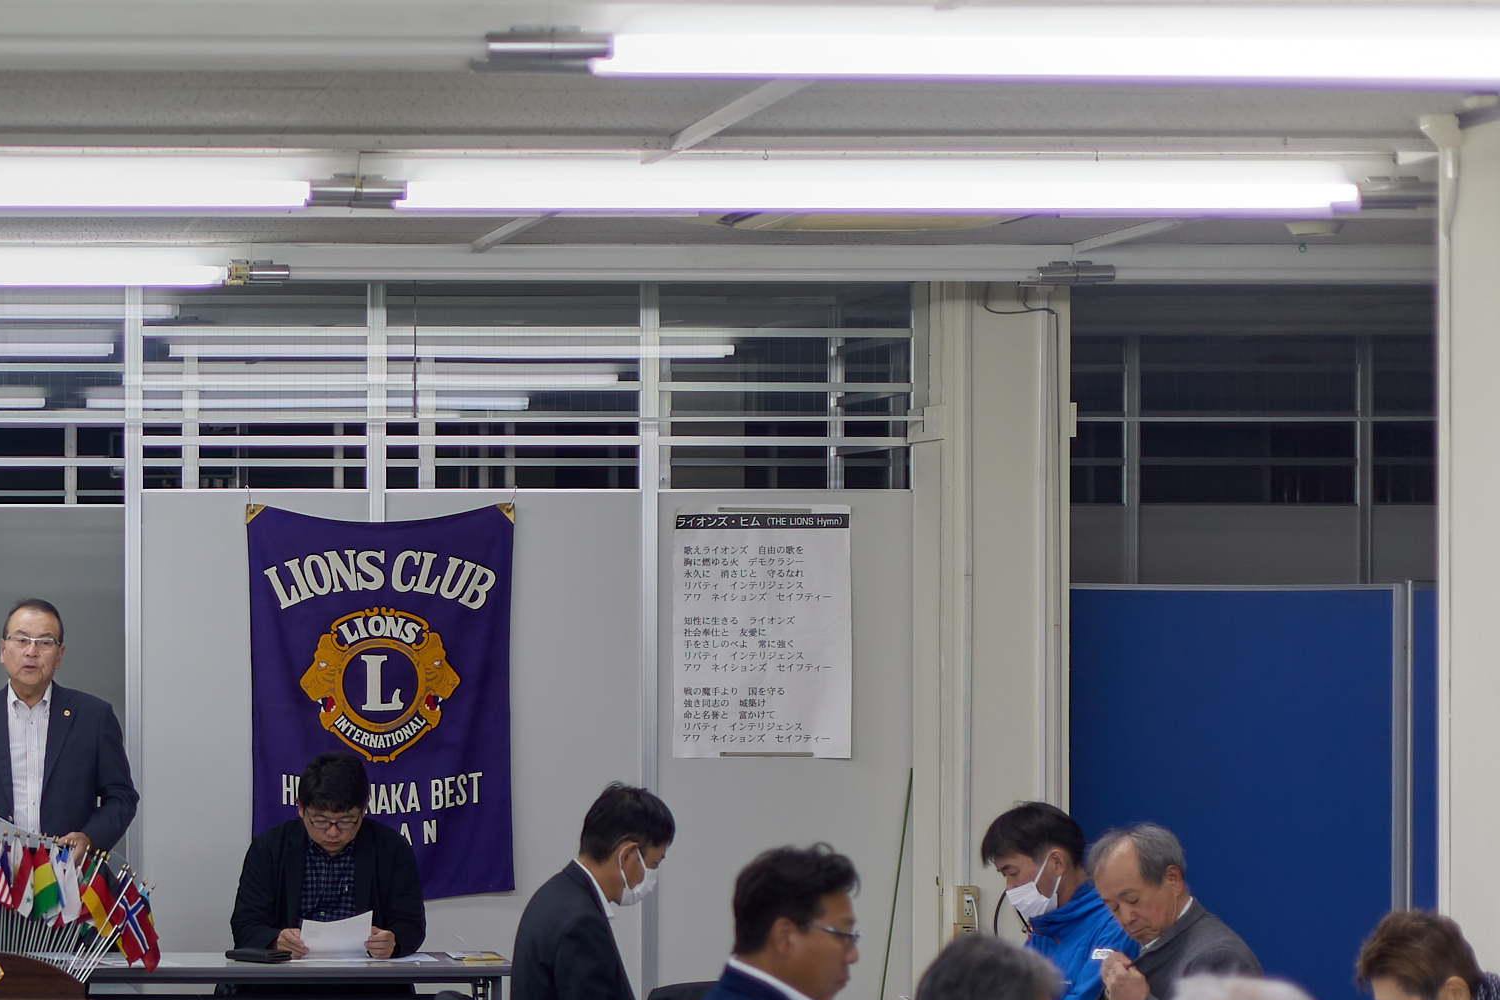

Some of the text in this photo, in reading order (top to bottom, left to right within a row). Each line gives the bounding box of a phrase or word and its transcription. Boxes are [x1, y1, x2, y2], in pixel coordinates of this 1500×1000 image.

[676, 515, 844, 527] ライオンズ・ヒム （THE LIONS Hymn）
[683, 545, 804, 556] 歌えライオンズ 自由の歌を
[683, 556, 805, 567] 胸に燃ゆる火 デモクラシー
[683, 568, 805, 579] 永久に 消さじと 守るなれ
[263, 549, 496, 610] LIONS CLUB
[684, 580, 805, 591] リバティ インテリジェンス
[683, 592, 833, 602] アワ ネイションズ セイフティー
[683, 615, 796, 626] 知性に生きる ライオンズ
[338, 615, 422, 644] LIONS
[683, 627, 768, 638] 社会奉仕と 友愛に
[757, 639, 795, 649] 常に強く
[684, 651, 805, 661] リバティ インテリジェンス
[683, 662, 833, 673] アワ ネイションズ セイフティー
[360, 655, 404, 712] L
[748, 686, 786, 697] 国を守る
[683, 698, 731, 709] 強き同志の
[333, 714, 426, 749] INTERNATIONAL
[684, 722, 804, 732] リバティ インテリジェンス
[682, 733, 832, 743] アワ ネイションズ セイフティー
[430, 771, 483, 811] BEST
